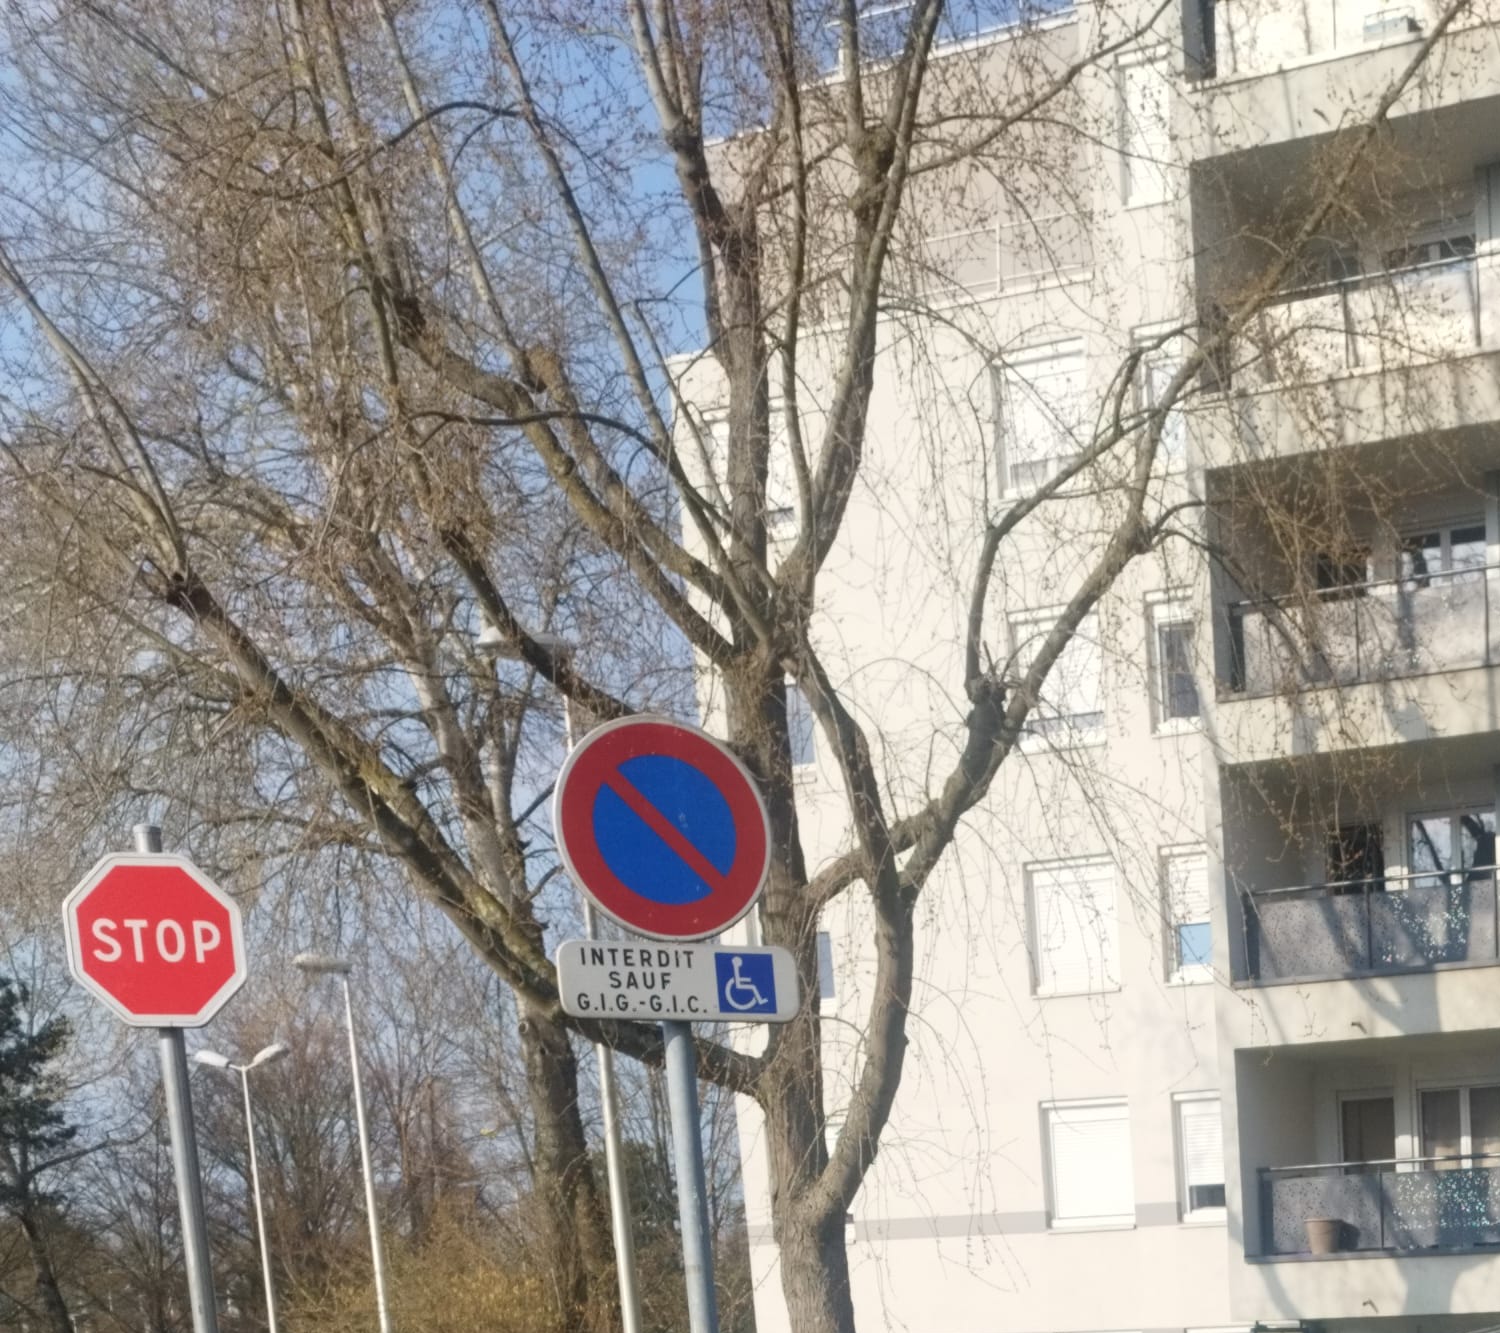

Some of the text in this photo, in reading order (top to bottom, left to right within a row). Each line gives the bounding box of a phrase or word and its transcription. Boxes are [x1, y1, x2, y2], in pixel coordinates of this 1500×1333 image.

[91, 917, 221, 964] STOP
[580, 947, 694, 968] INTERDIT
[608, 971, 672, 990] SAUF
